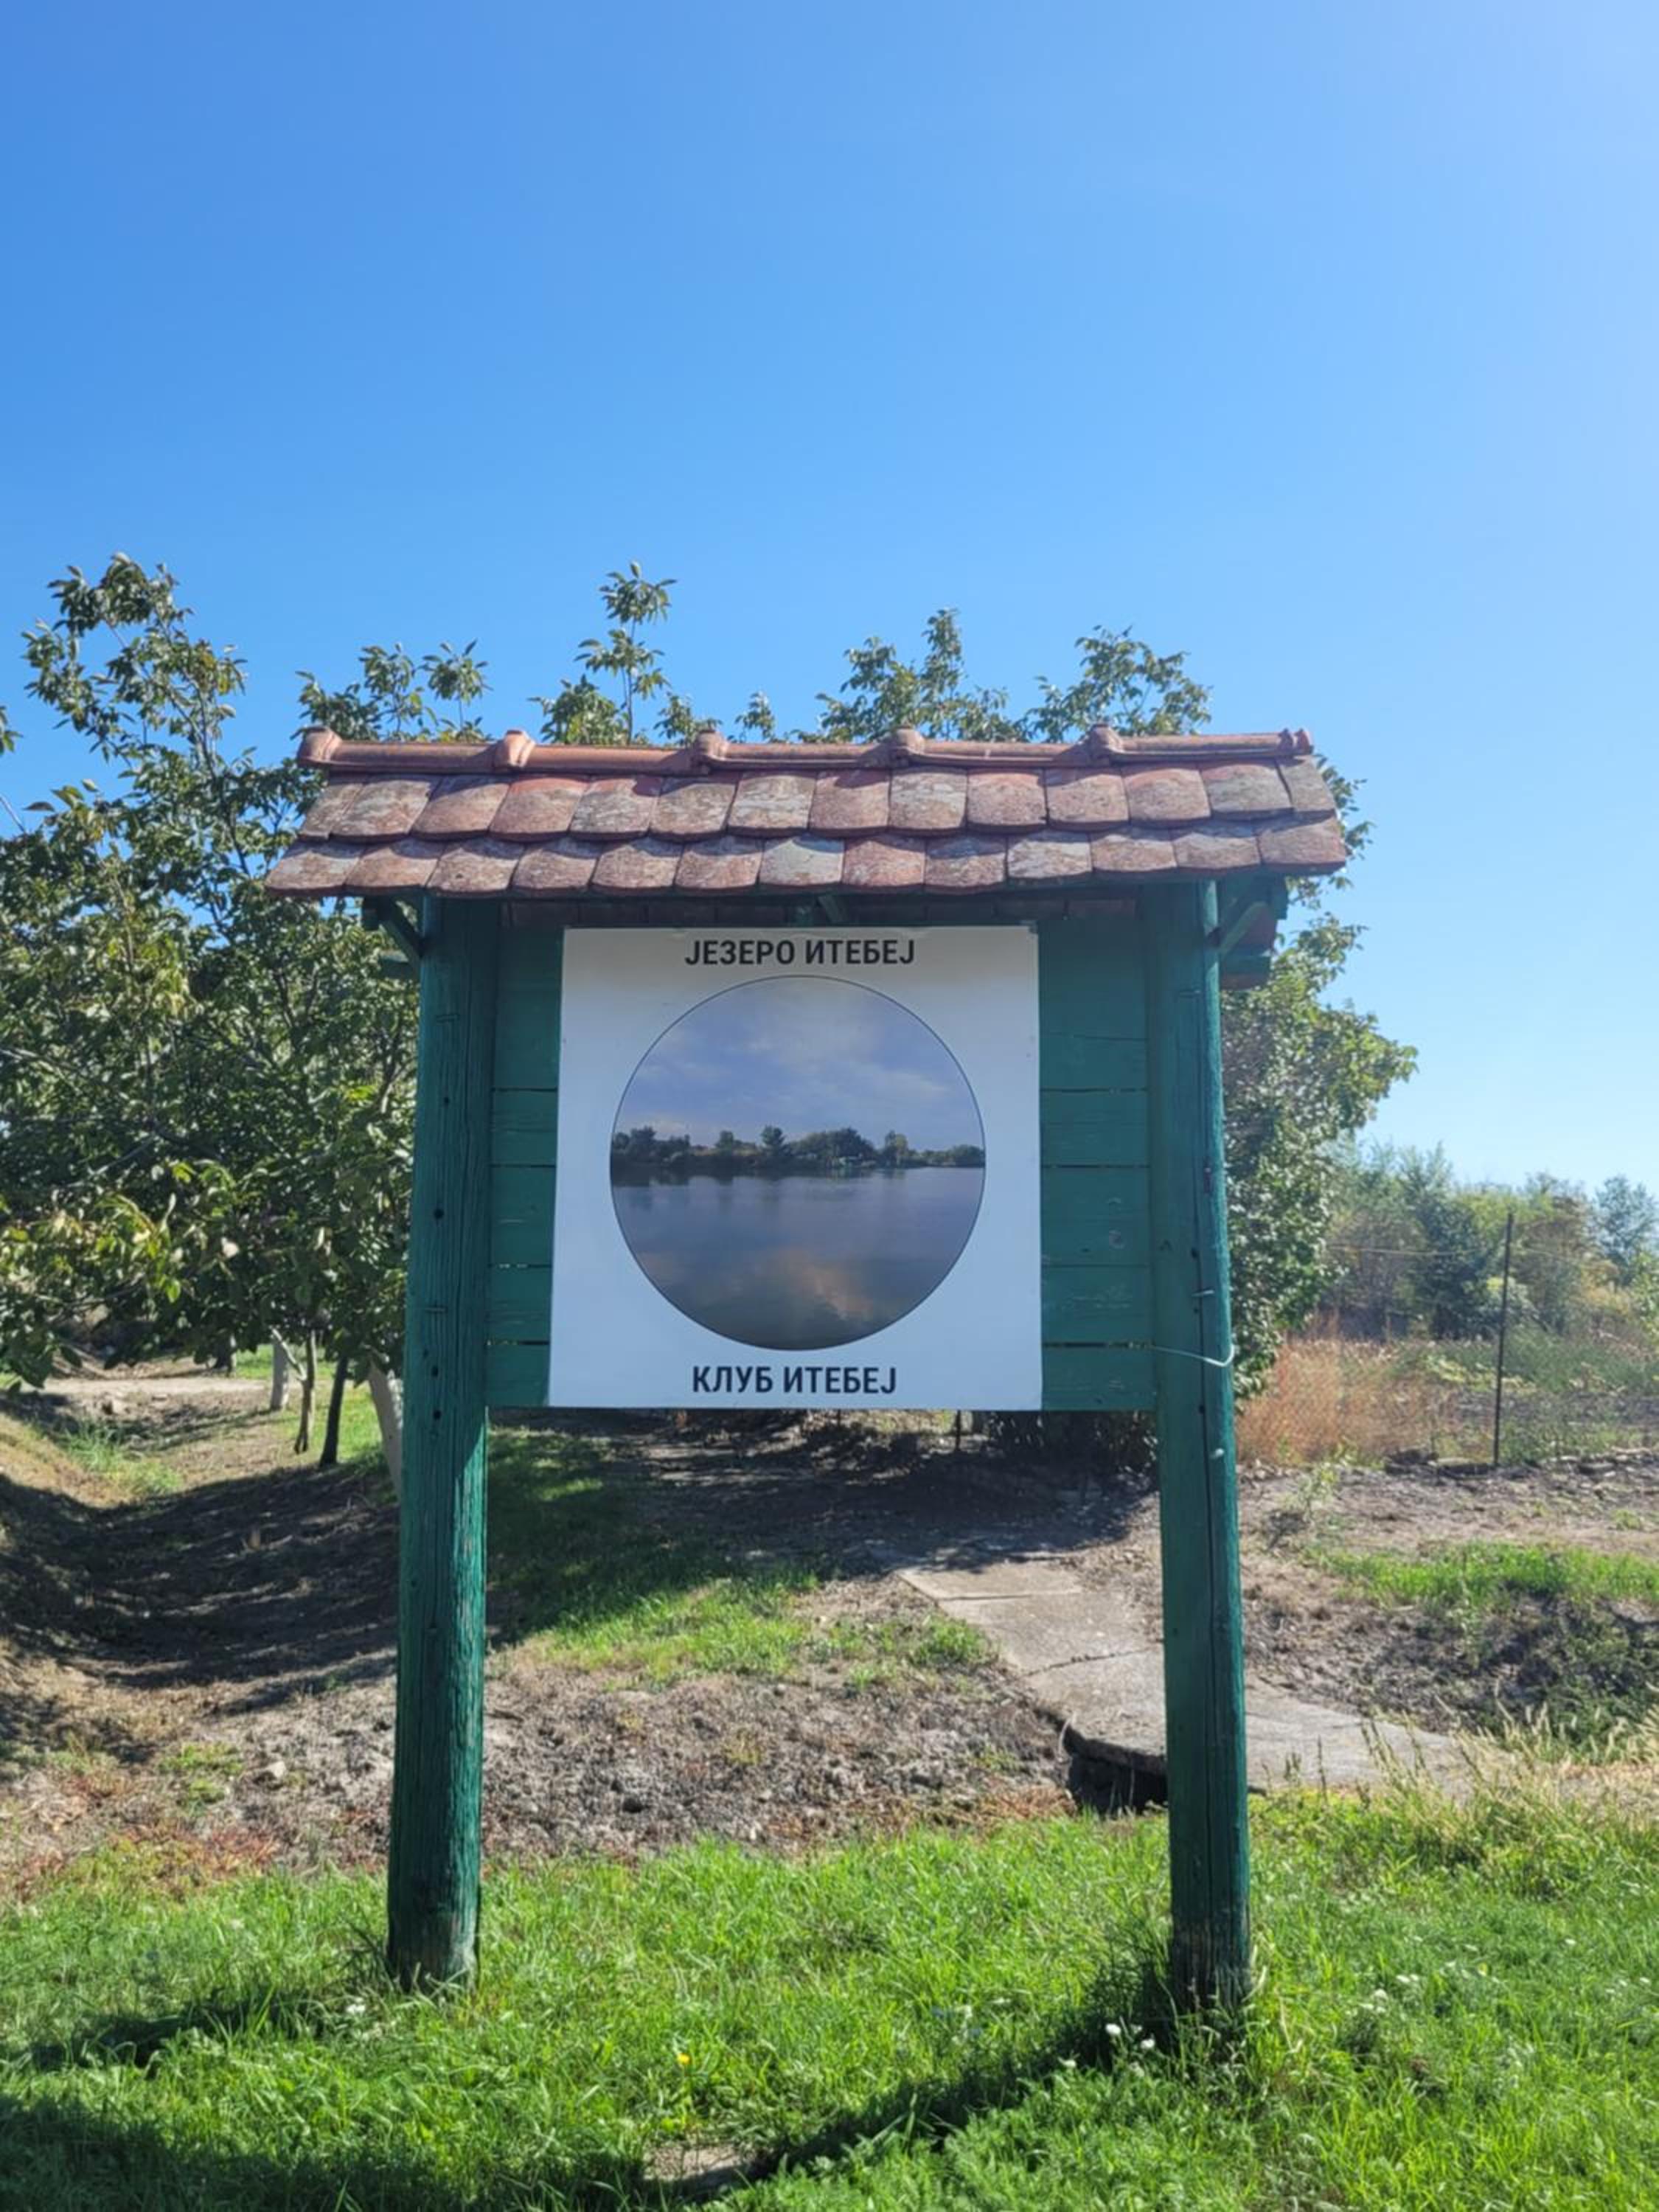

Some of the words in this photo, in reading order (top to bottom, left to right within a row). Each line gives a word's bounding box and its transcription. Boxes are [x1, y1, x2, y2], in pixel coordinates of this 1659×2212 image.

[684, 939, 795, 965] ЈЕЗЕРО
[805, 939, 914, 964] ИТЕБЕЈ
[692, 1366, 773, 1394] КЛУБ
[783, 1366, 896, 1394] ИТЕБЕЈ
